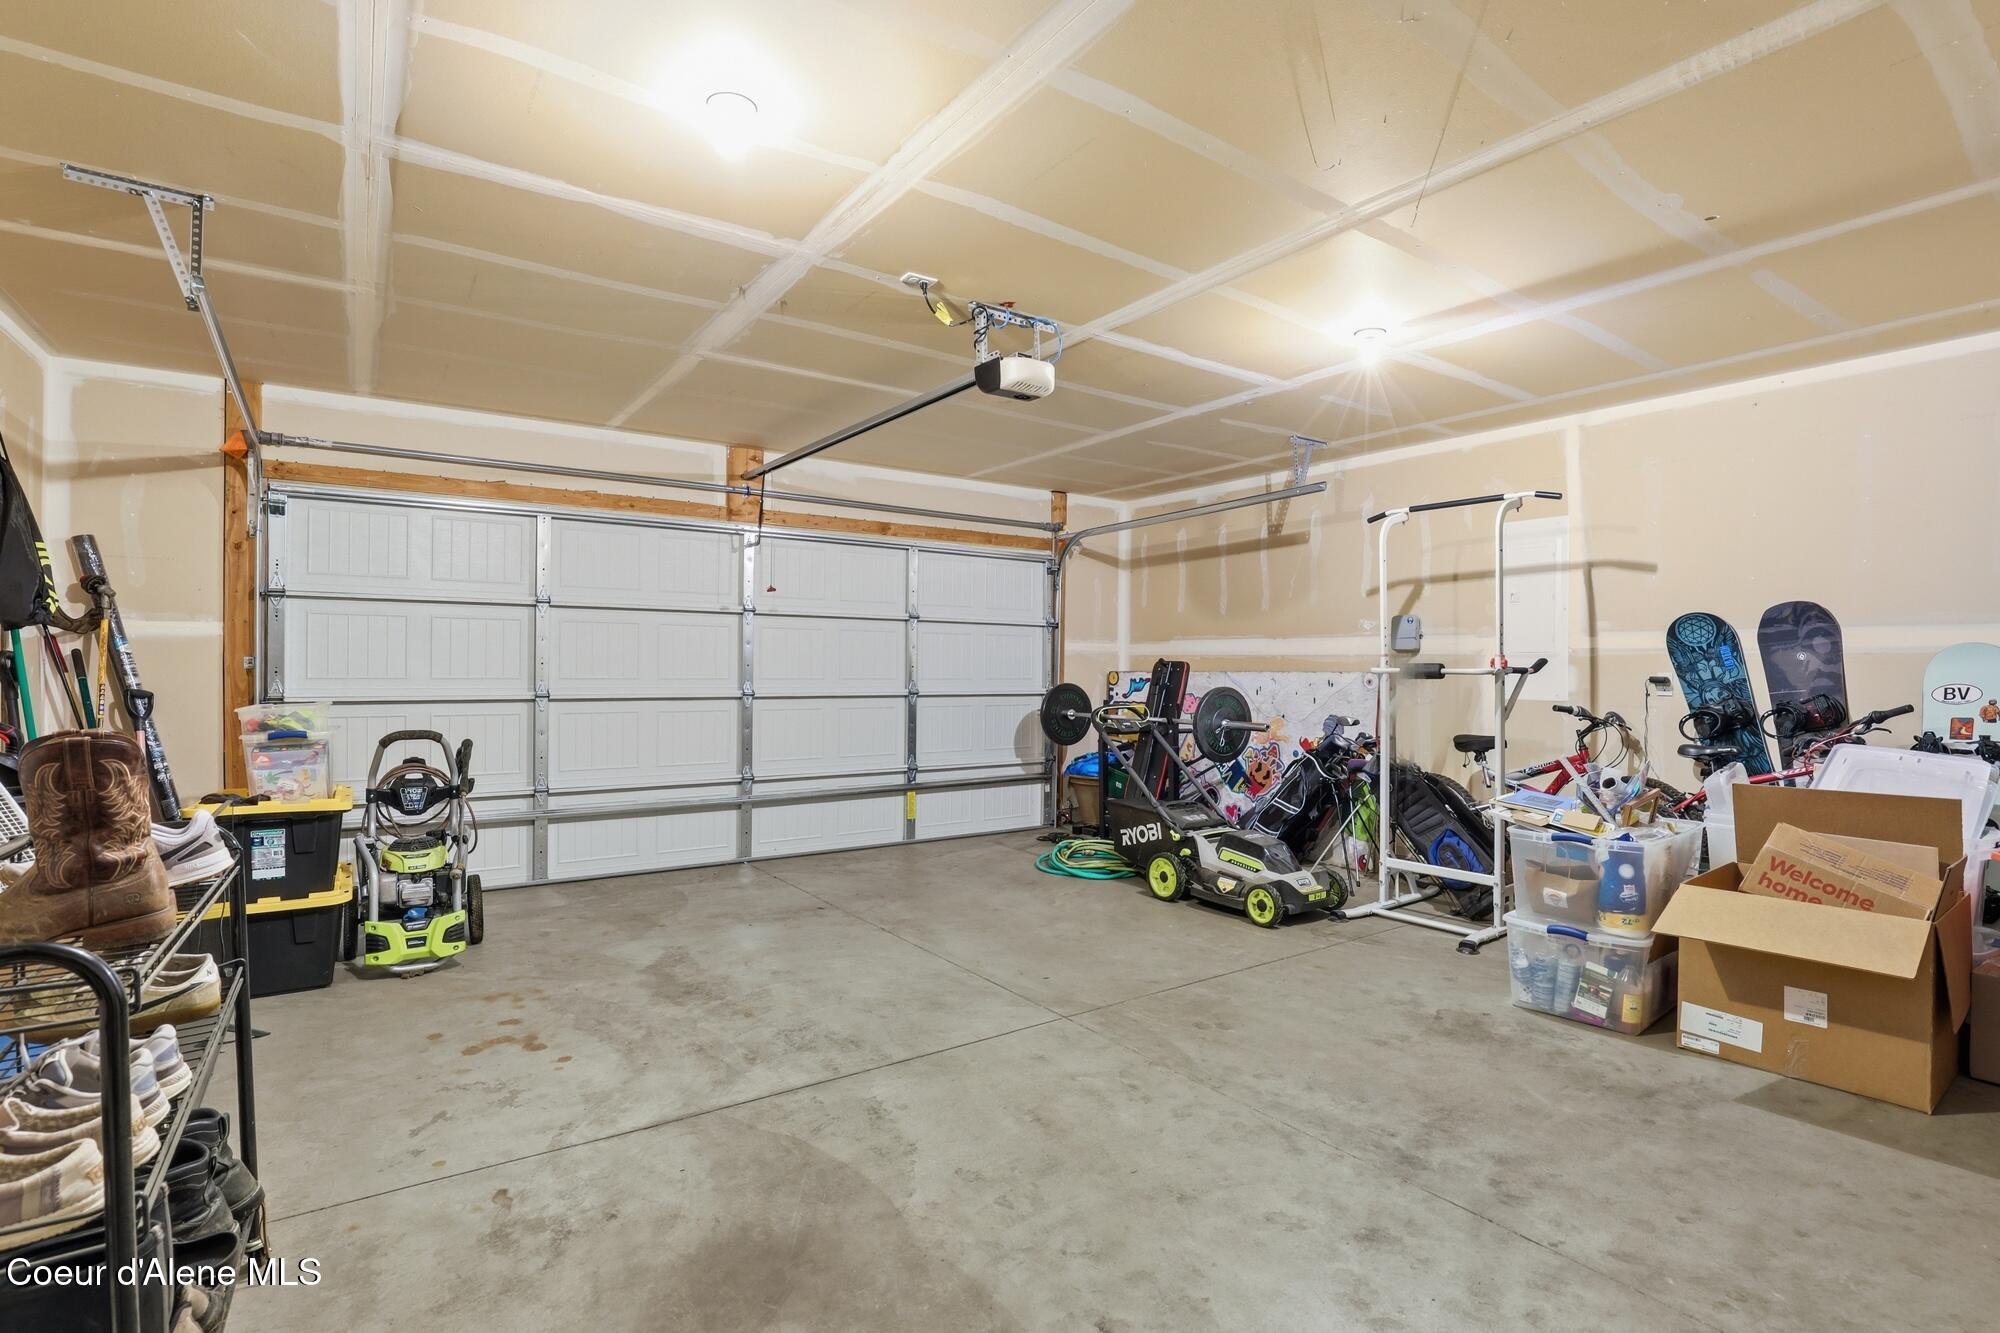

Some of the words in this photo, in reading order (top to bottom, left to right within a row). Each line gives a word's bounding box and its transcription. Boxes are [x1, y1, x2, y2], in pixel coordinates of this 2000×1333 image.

[1943, 686, 1971, 701] BV
[1120, 822, 1162, 846] RYOBI
[1769, 855, 1875, 912] Welcome
